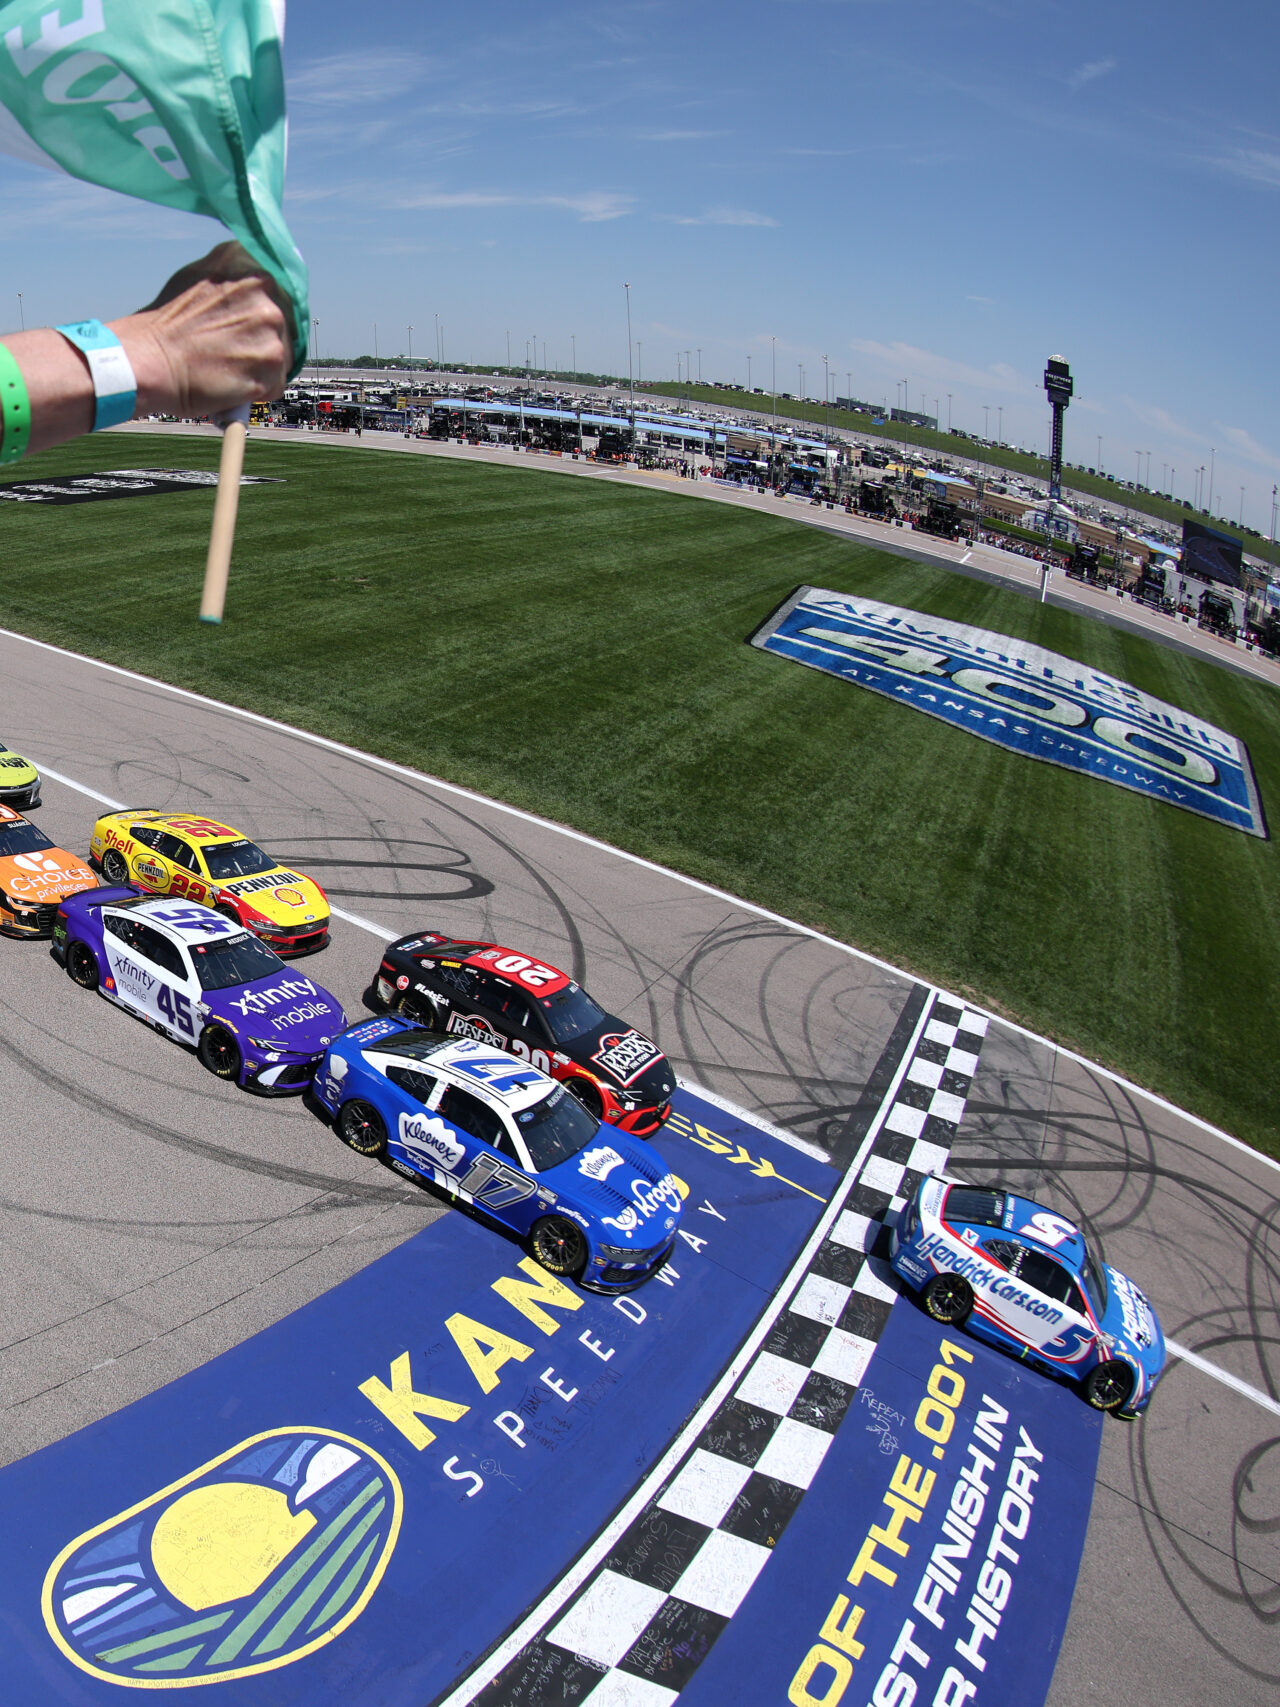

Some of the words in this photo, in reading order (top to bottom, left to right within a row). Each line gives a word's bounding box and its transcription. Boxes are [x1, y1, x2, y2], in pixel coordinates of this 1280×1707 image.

[814, 601, 1232, 755] AdventHealth
[798, 627, 1220, 786] 400
[841, 668, 881, 682] AT
[894, 684, 1031, 736] KANSAS
[1039, 735, 1187, 800] SPEEDWAY
[104, 829, 136, 856] Shell
[10, 867, 94, 892] CHOICE
[137, 862, 165, 879] PENNZOIL
[169, 873, 207, 902] 22
[225, 872, 304, 897] PENNZOIL
[36, 881, 89, 902] privileges
[114, 955, 156, 991] xfinity
[119, 977, 148, 1003] mobile
[157, 983, 195, 1039] 45
[229, 978, 318, 1016] xfinity
[414, 982, 451, 1008] #LetsEat
[271, 1001, 332, 1031] mobile
[404, 1120, 458, 1163] Kleenex
[392, 1160, 416, 1176] FORD
[458, 1151, 539, 1211] 17
[585, 1150, 620, 1178] Kleenex
[630, 1173, 682, 1218] Kroge
[914, 1233, 1064, 1325] HendrickCars.com
[442, 1199, 728, 1498] SPEEDWAY
[1040, 1323, 1097, 1363] 5
[787, 1593, 866, 1707] OF
[846, 1454, 938, 1588] THE
[914, 1338, 975, 1461] .001
[866, 1618, 931, 1707] ST
[912, 1442, 996, 1631] FINISH
[972, 1393, 1010, 1452] IN
[954, 1424, 1044, 1673] HISTORY
